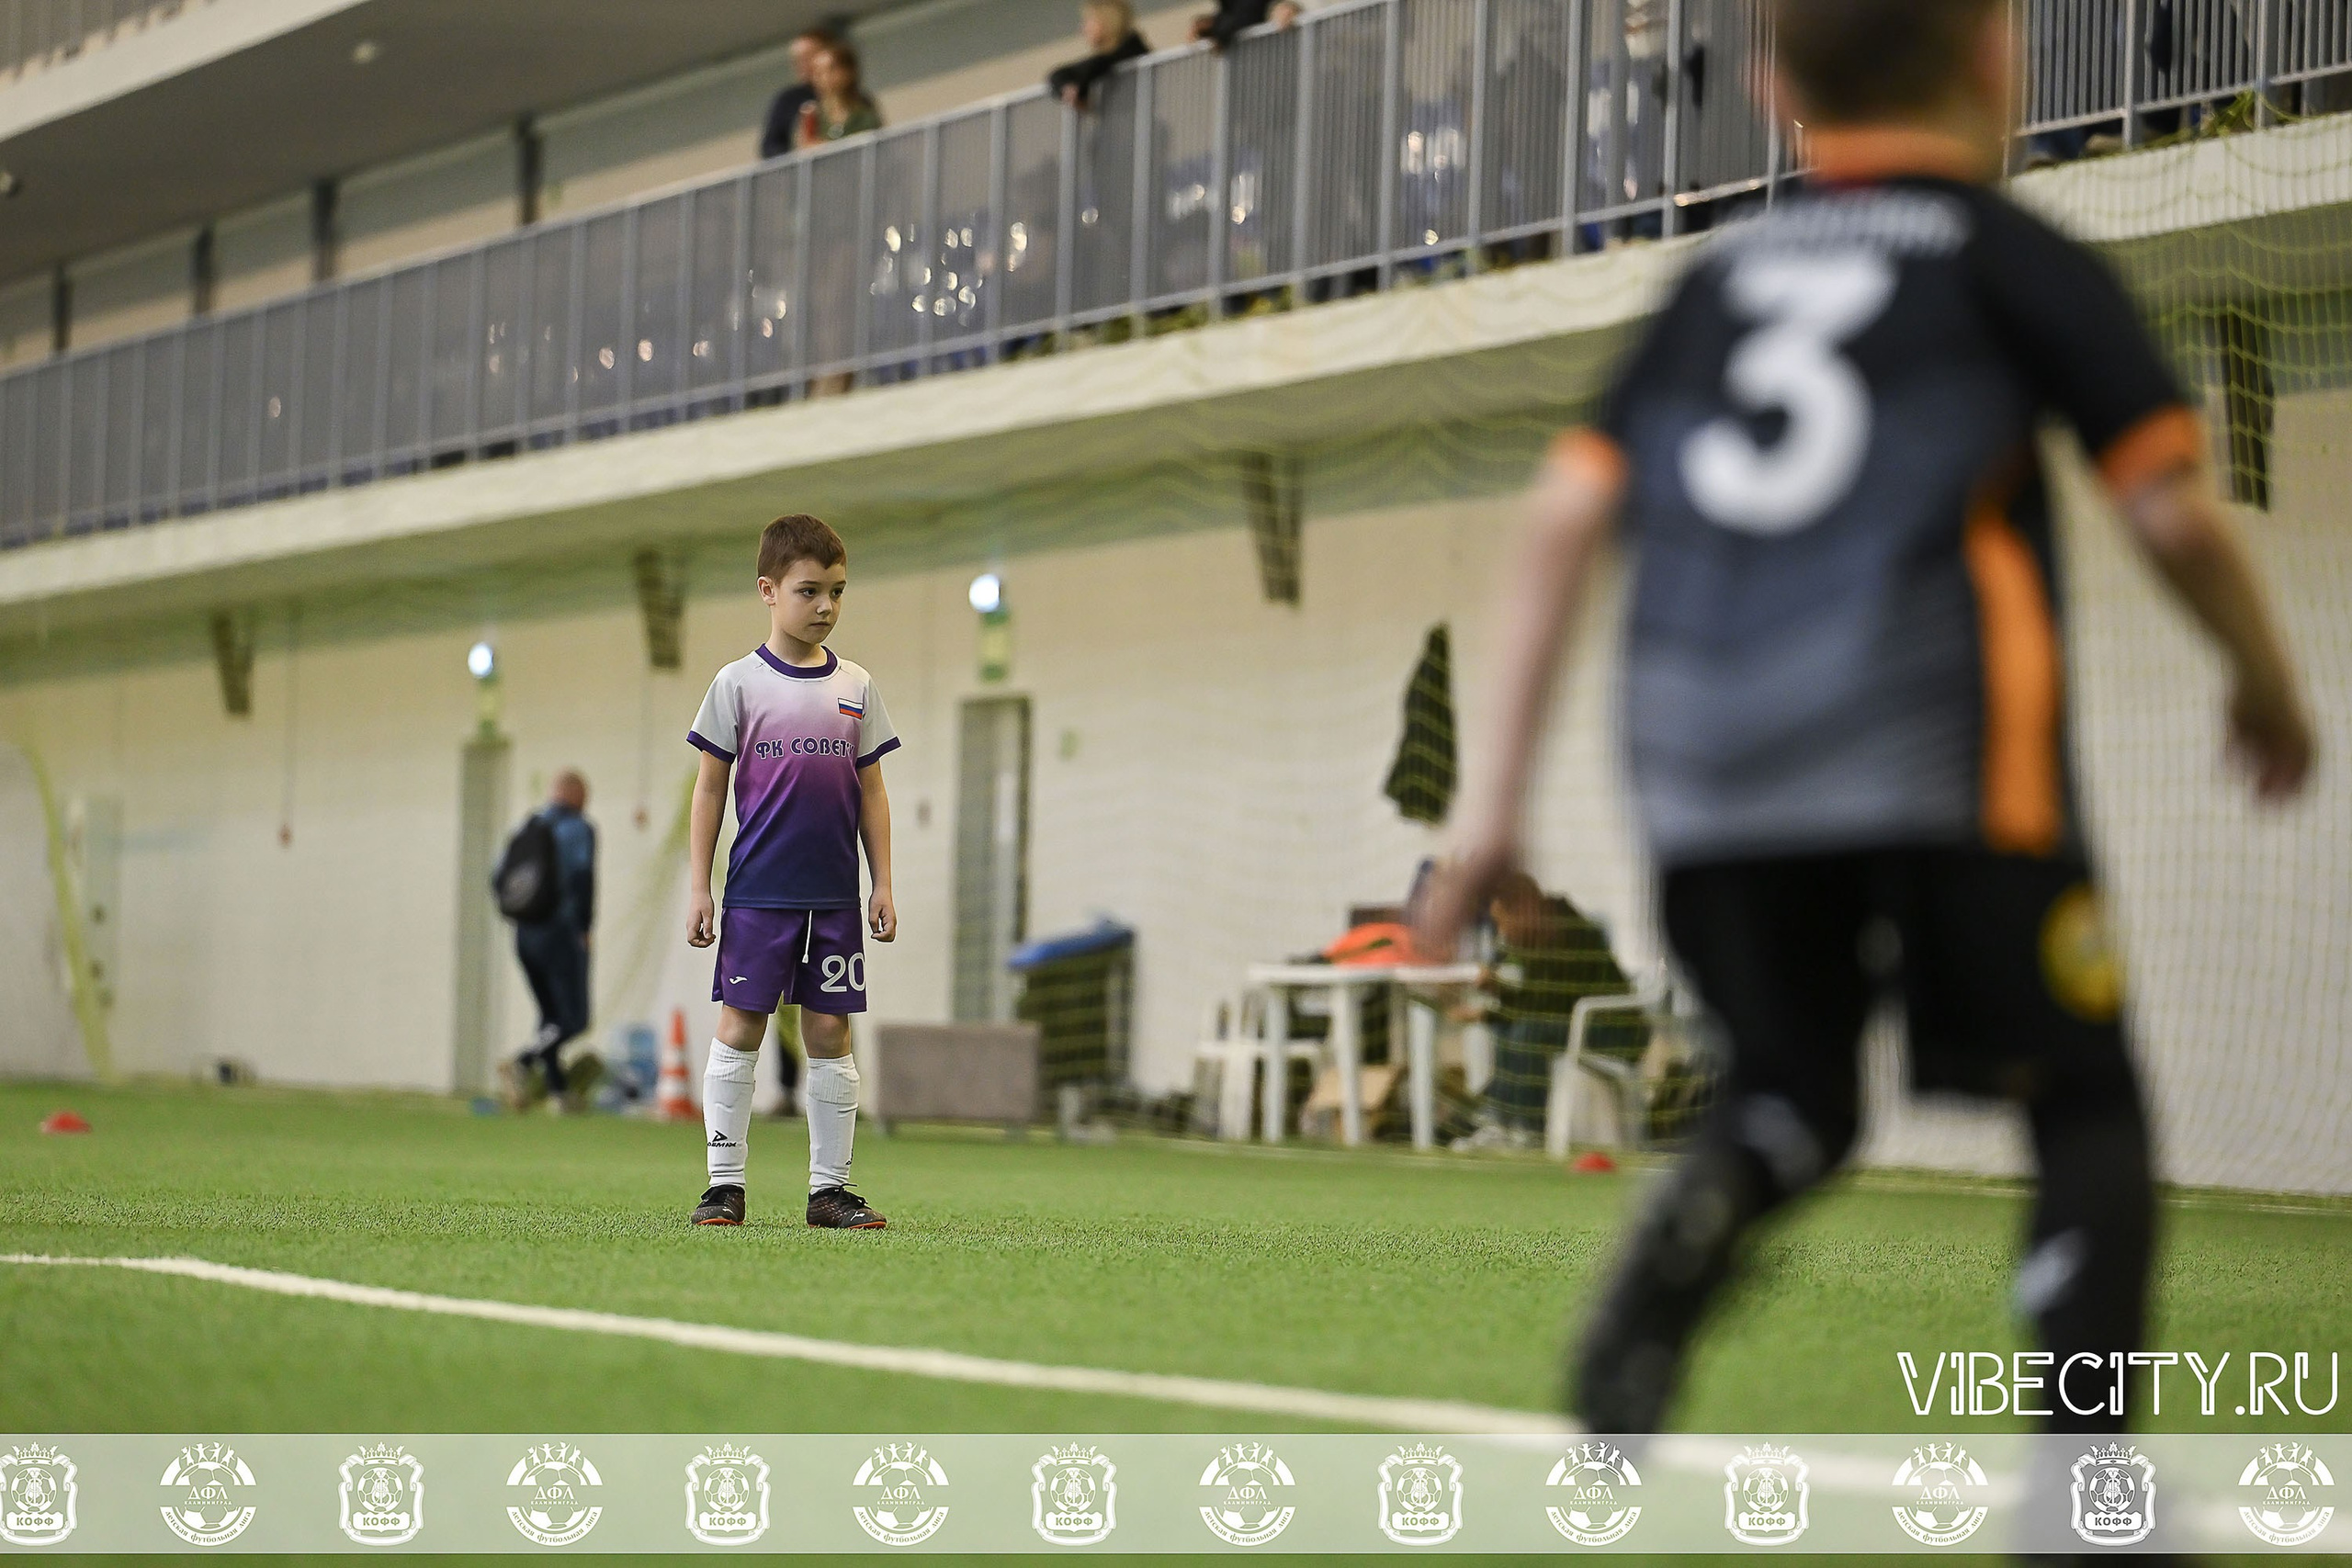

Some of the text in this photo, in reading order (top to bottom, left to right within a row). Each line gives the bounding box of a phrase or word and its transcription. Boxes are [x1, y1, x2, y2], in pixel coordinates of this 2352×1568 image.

[1679, 252, 1898, 536] 3
[754, 739, 784, 760] ФК
[820, 952, 865, 992] 20
